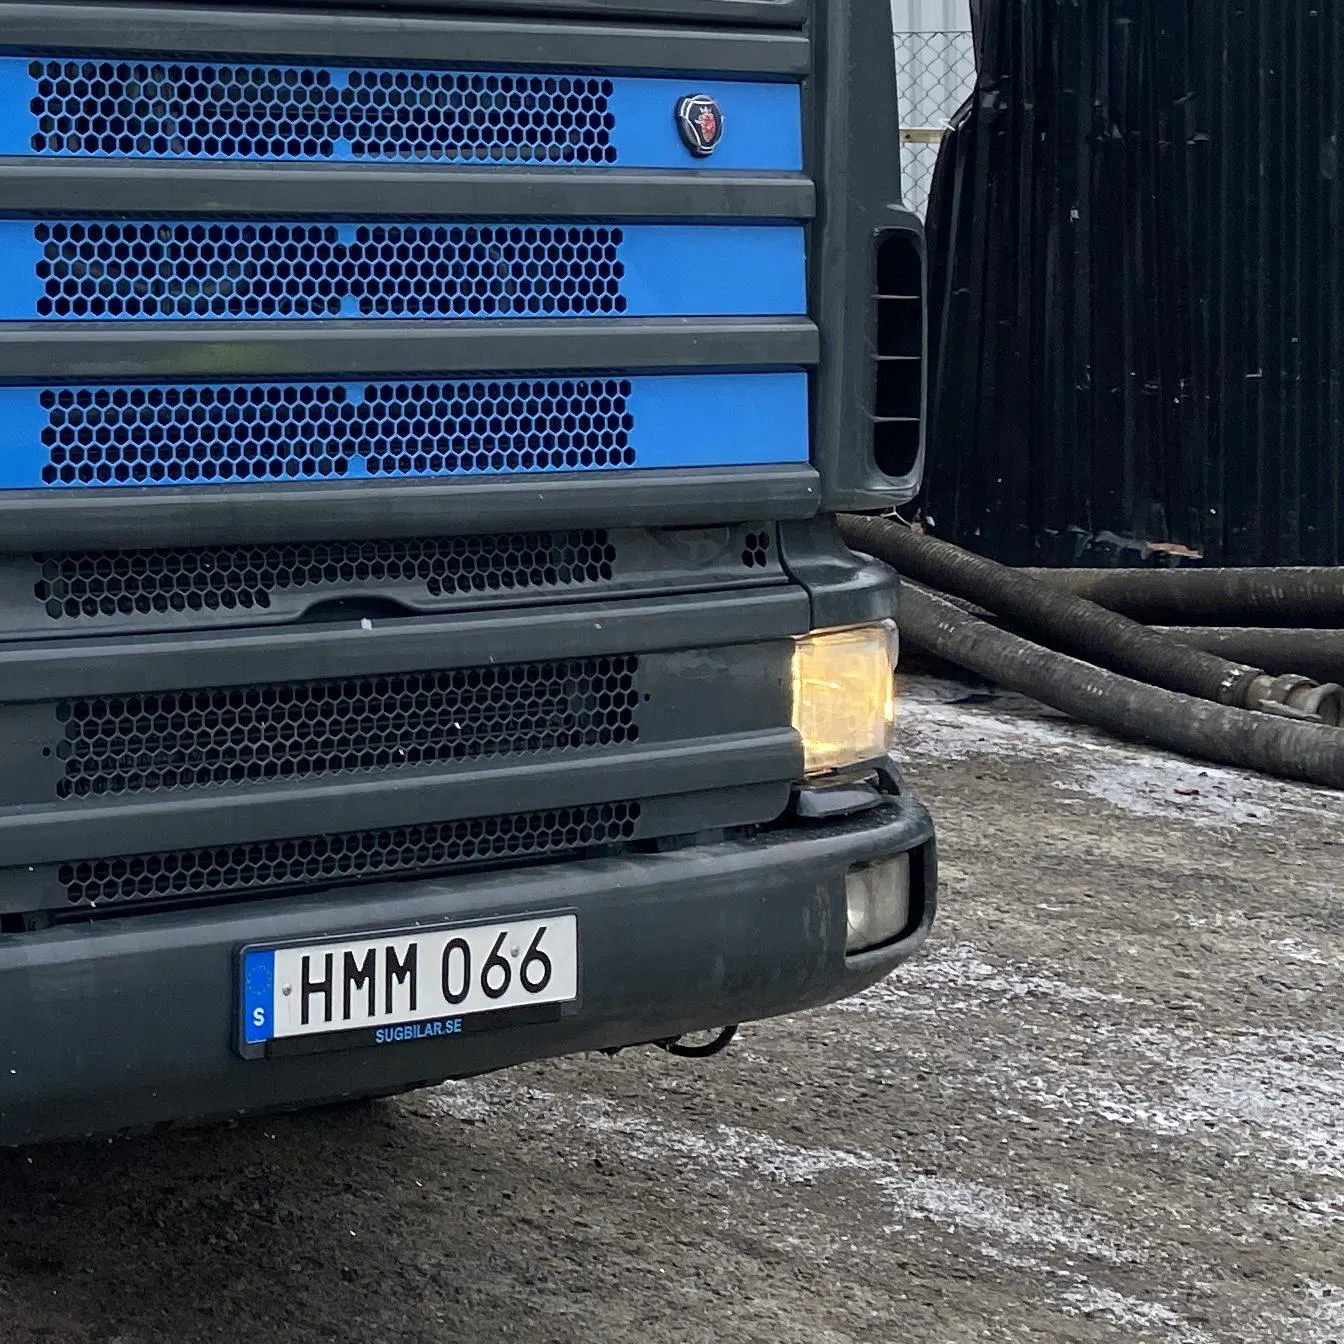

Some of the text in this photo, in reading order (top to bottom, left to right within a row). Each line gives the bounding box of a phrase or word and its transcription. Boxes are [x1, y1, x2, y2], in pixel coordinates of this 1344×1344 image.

[300, 925, 552, 1026] HMM 066
[252, 1007, 266, 1027] S
[375, 1019, 463, 1045] SUGBILAR.SE
